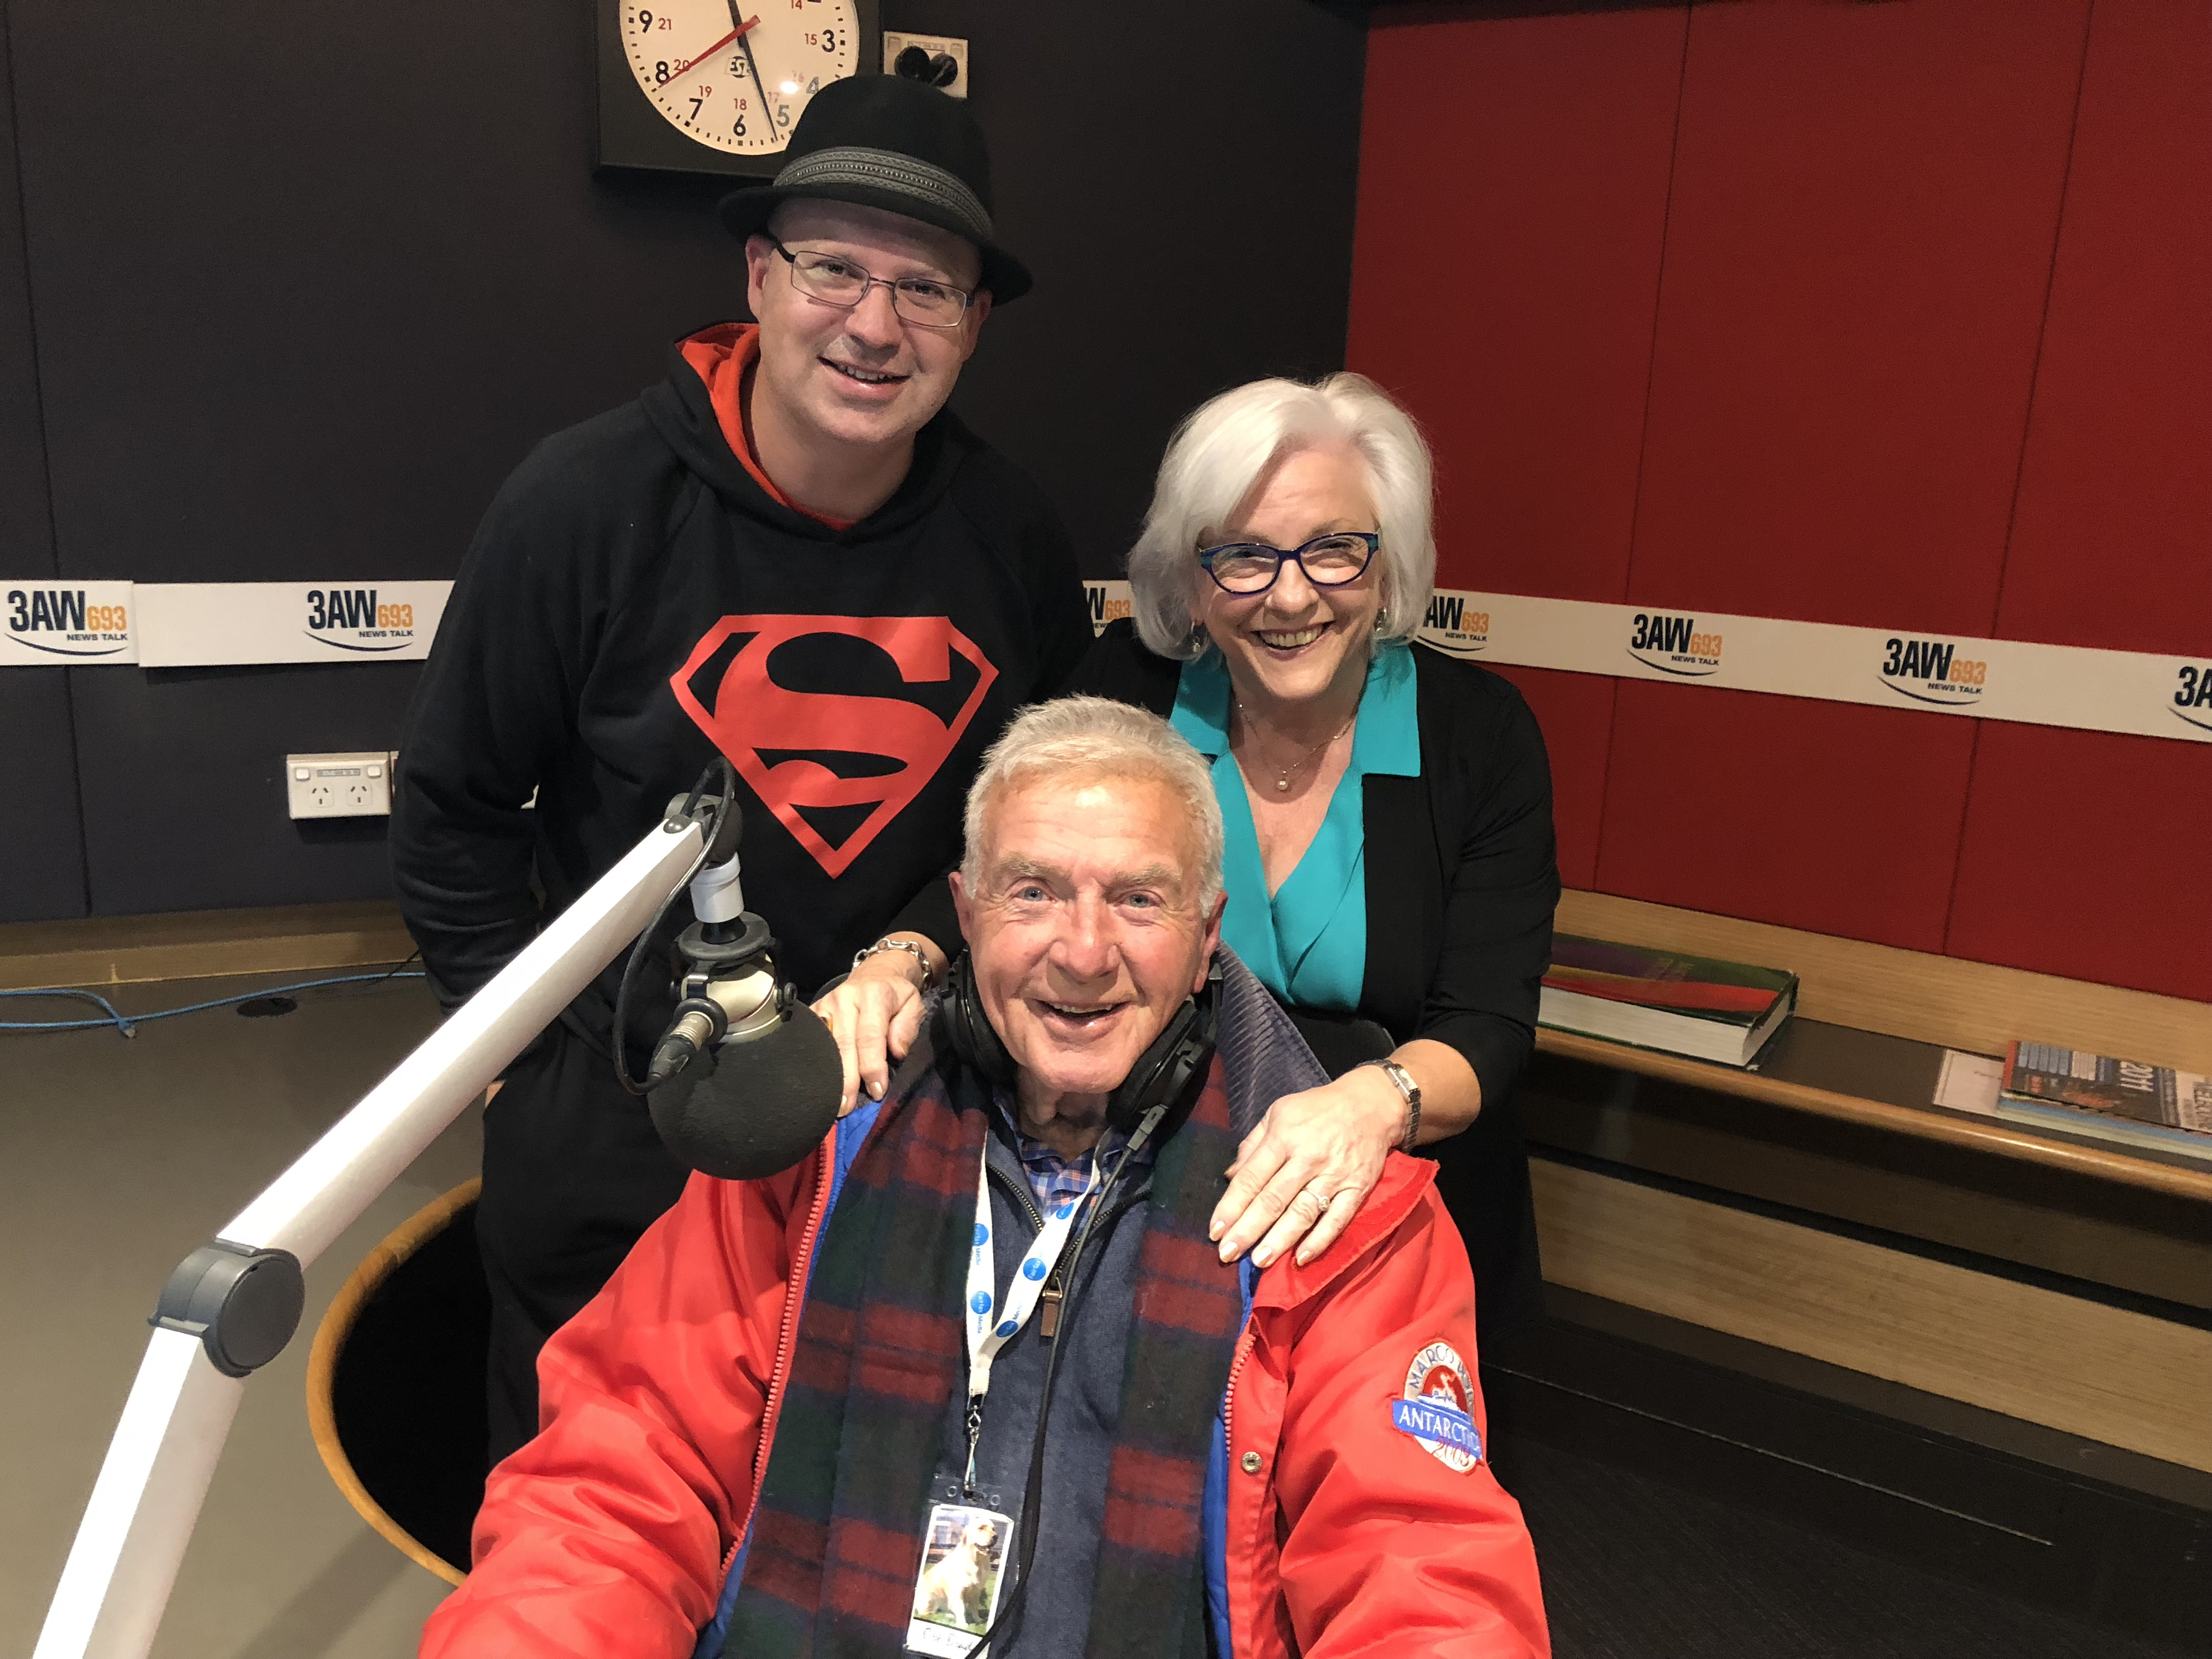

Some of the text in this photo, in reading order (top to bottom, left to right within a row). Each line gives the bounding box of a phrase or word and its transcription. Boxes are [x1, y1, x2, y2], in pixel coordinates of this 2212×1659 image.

[639, 10, 653, 33] 9
[658, 18, 672, 30] 21
[805, 33, 818, 45] 15
[822, 29, 836, 53] 3
[655, 61, 670, 85] 8
[674, 59, 690, 71] 20
[699, 86, 712, 97] 19
[806, 76, 819, 95] 4
[734, 98, 747, 110] 18
[768, 92, 780, 103] 17
[689, 97, 703, 120] 7
[776, 105, 790, 127] 5
[733, 114, 746, 137] 6
[1928, 682, 1983, 694] NEWS TALK
[1410, 1344, 1455, 1389] MARCO
